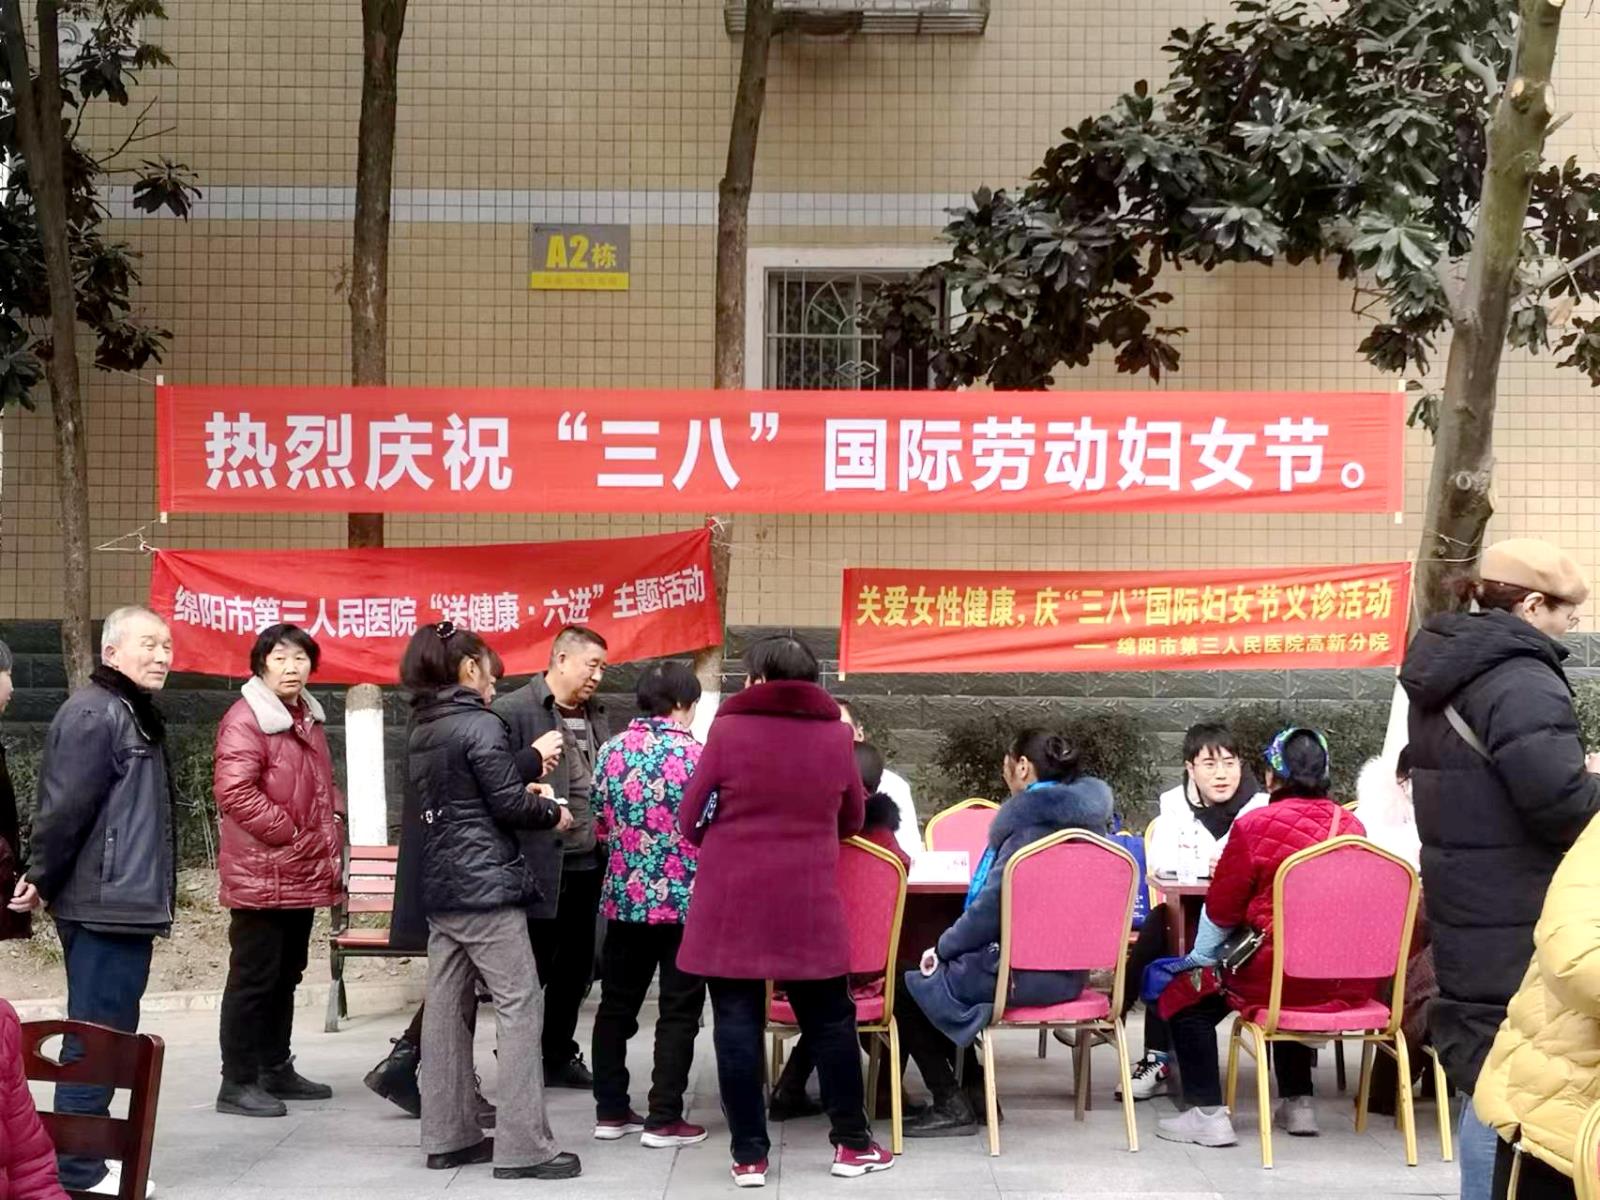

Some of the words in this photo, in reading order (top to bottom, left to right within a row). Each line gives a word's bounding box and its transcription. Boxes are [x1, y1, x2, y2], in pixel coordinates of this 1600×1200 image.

[546, 233, 617, 269] A2栋
[204, 411, 512, 491] 热烈庆祝
[557, 411, 780, 490] “三八”
[824, 416, 1365, 492] 国际劳动妇女节。
[174, 584, 417, 638] 绵阳市第三人民医院
[612, 564, 705, 619] 主题活动
